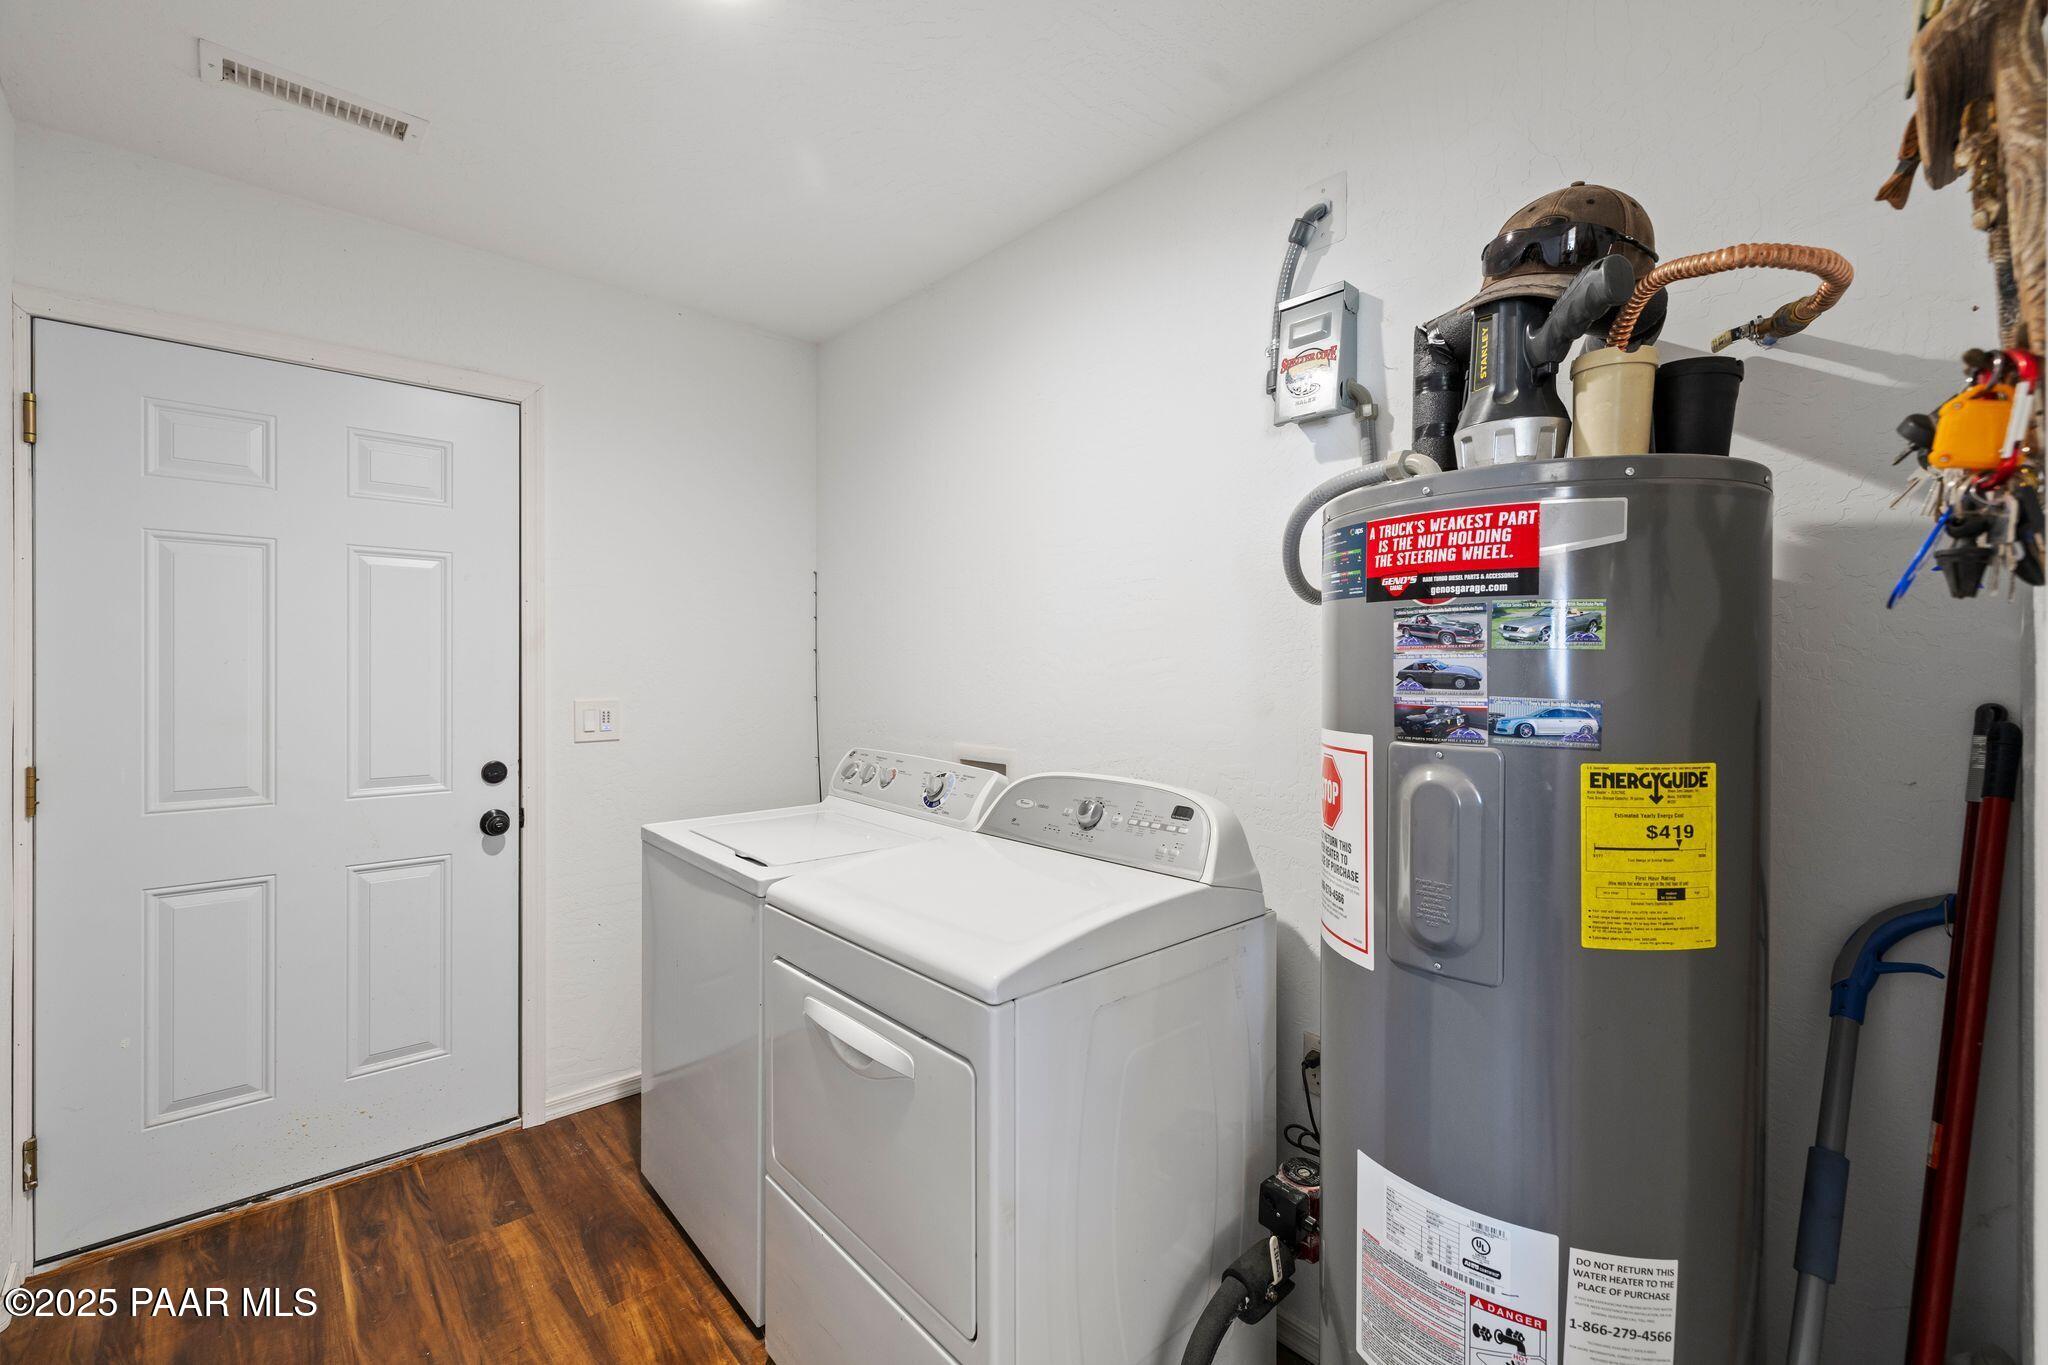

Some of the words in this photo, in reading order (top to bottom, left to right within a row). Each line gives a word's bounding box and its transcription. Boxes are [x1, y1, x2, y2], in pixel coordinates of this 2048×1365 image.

[1480, 327, 1489, 380] STANLEY
[1369, 527, 1376, 541] A
[1379, 520, 1425, 539] TRUCK'S
[1430, 513, 1493, 532] WEAKEST
[1498, 510, 1538, 526] PART
[1378, 540, 1389, 554] IS
[1393, 536, 1413, 551] THE
[1418, 533, 1444, 549] NUT
[1448, 528, 1512, 546] HOLDING
[1375, 554, 1393, 568] THE
[1397, 548, 1456, 566] STEERING
[1462, 544, 1514, 561] WHEEL.
[1381, 575, 1418, 586] GENO'S
[1430, 583, 1508, 596] genosgarage.com
[1589, 771, 1709, 789] ENERGYGUIDE
[1322, 778, 1339, 805] TOP
[1646, 824, 1695, 840] $419
[1339, 839, 1352, 854] THIS
[1340, 853, 1348, 866] TO
[1331, 862, 1359, 883] PURCHASE
[1576, 1258, 1591, 1268] DO
[1594, 1261, 1615, 1272] NOT
[1617, 1264, 1654, 1276] RETURN
[1656, 1268, 1674, 1277] THIS
[1572, 1268, 1607, 1282] WATER
[1609, 1276, 1644, 1287] HEATER
[1646, 1280, 1658, 1288] TO
[1659, 1280, 1674, 1288] THE
[1440, 1280, 1466, 1296] CAUTION
[1577, 1282, 1607, 1294] PLACE
[1608, 1288, 1622, 1296] OF
[1623, 1290, 1671, 1301] PURCHASE
[1487, 1304, 1542, 1328] DANGER
[1569, 1318, 1672, 1342] 1-866-279-4566
